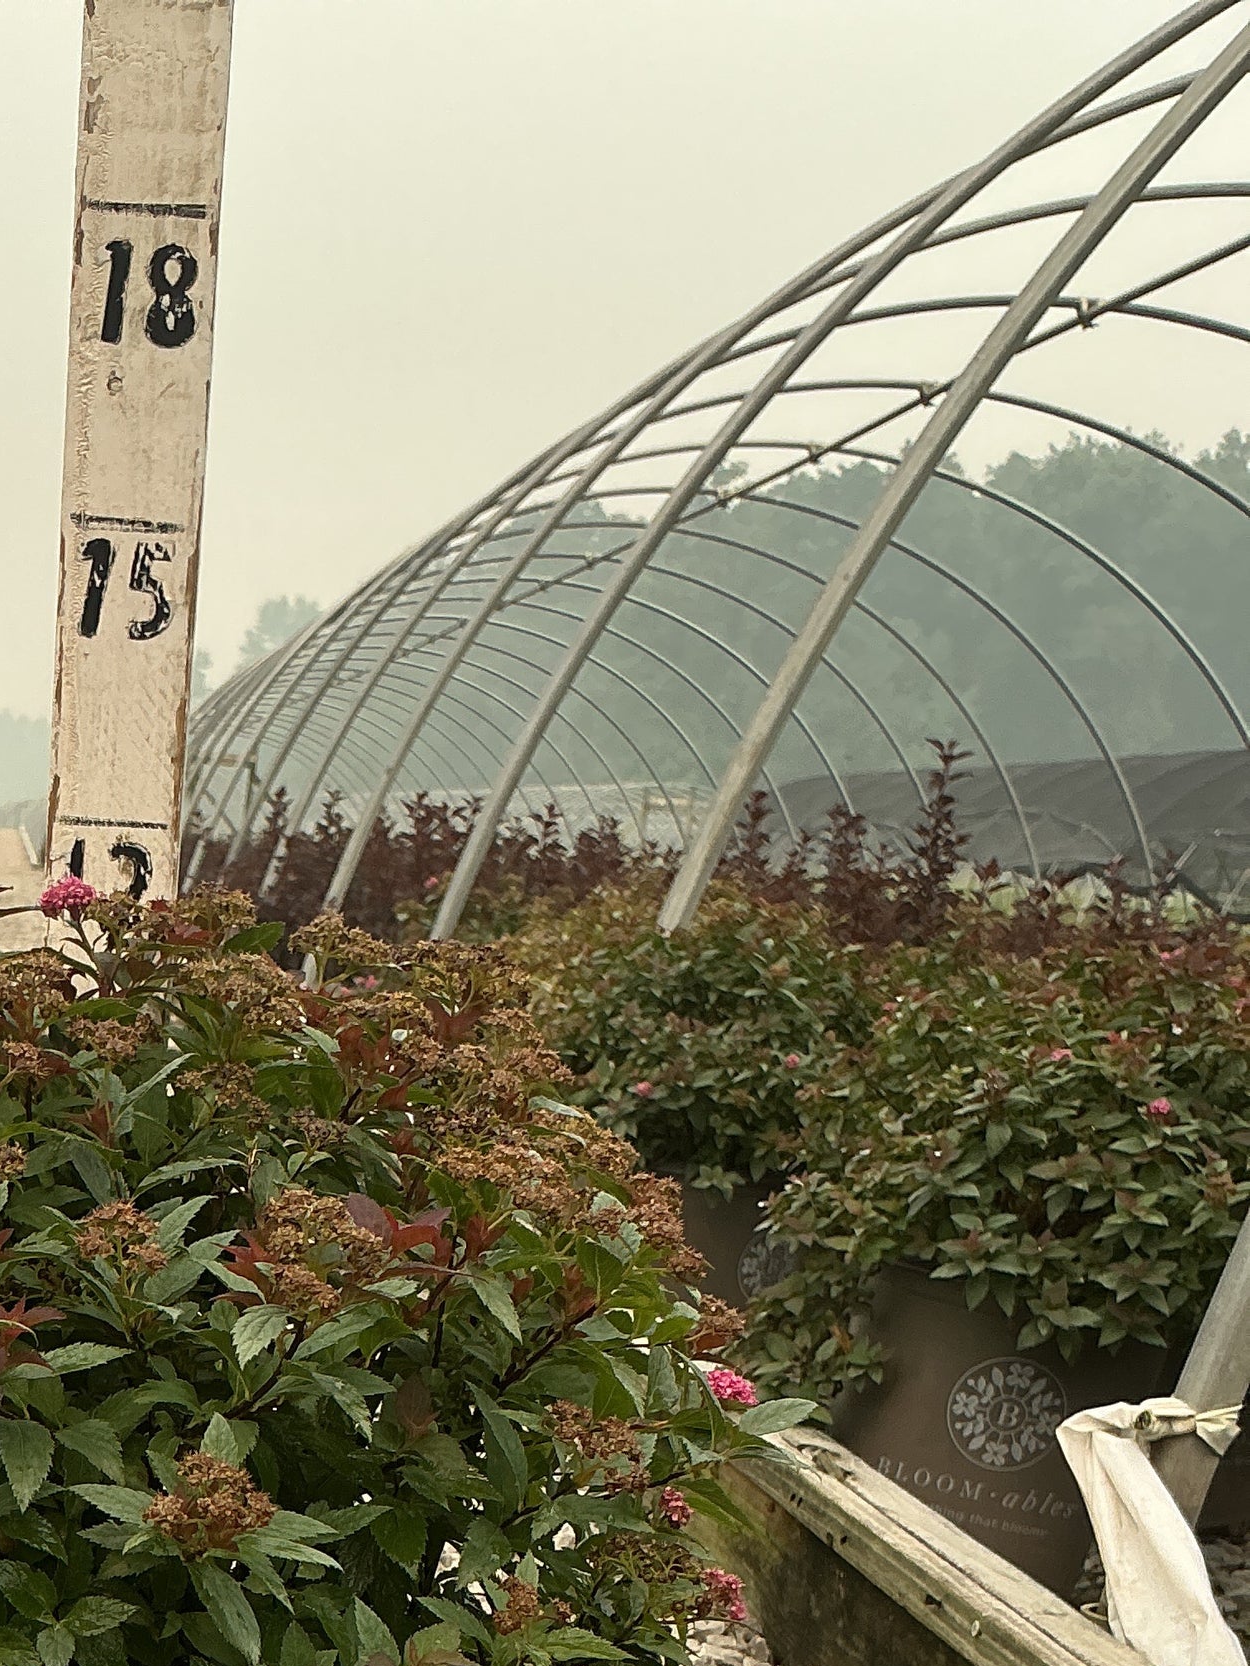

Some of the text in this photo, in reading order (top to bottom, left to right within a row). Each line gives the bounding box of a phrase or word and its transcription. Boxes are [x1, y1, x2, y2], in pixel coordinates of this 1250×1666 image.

[100, 239, 199, 348] 18
[77, 537, 177, 641] 15
[997, 1401, 1020, 1428] B
